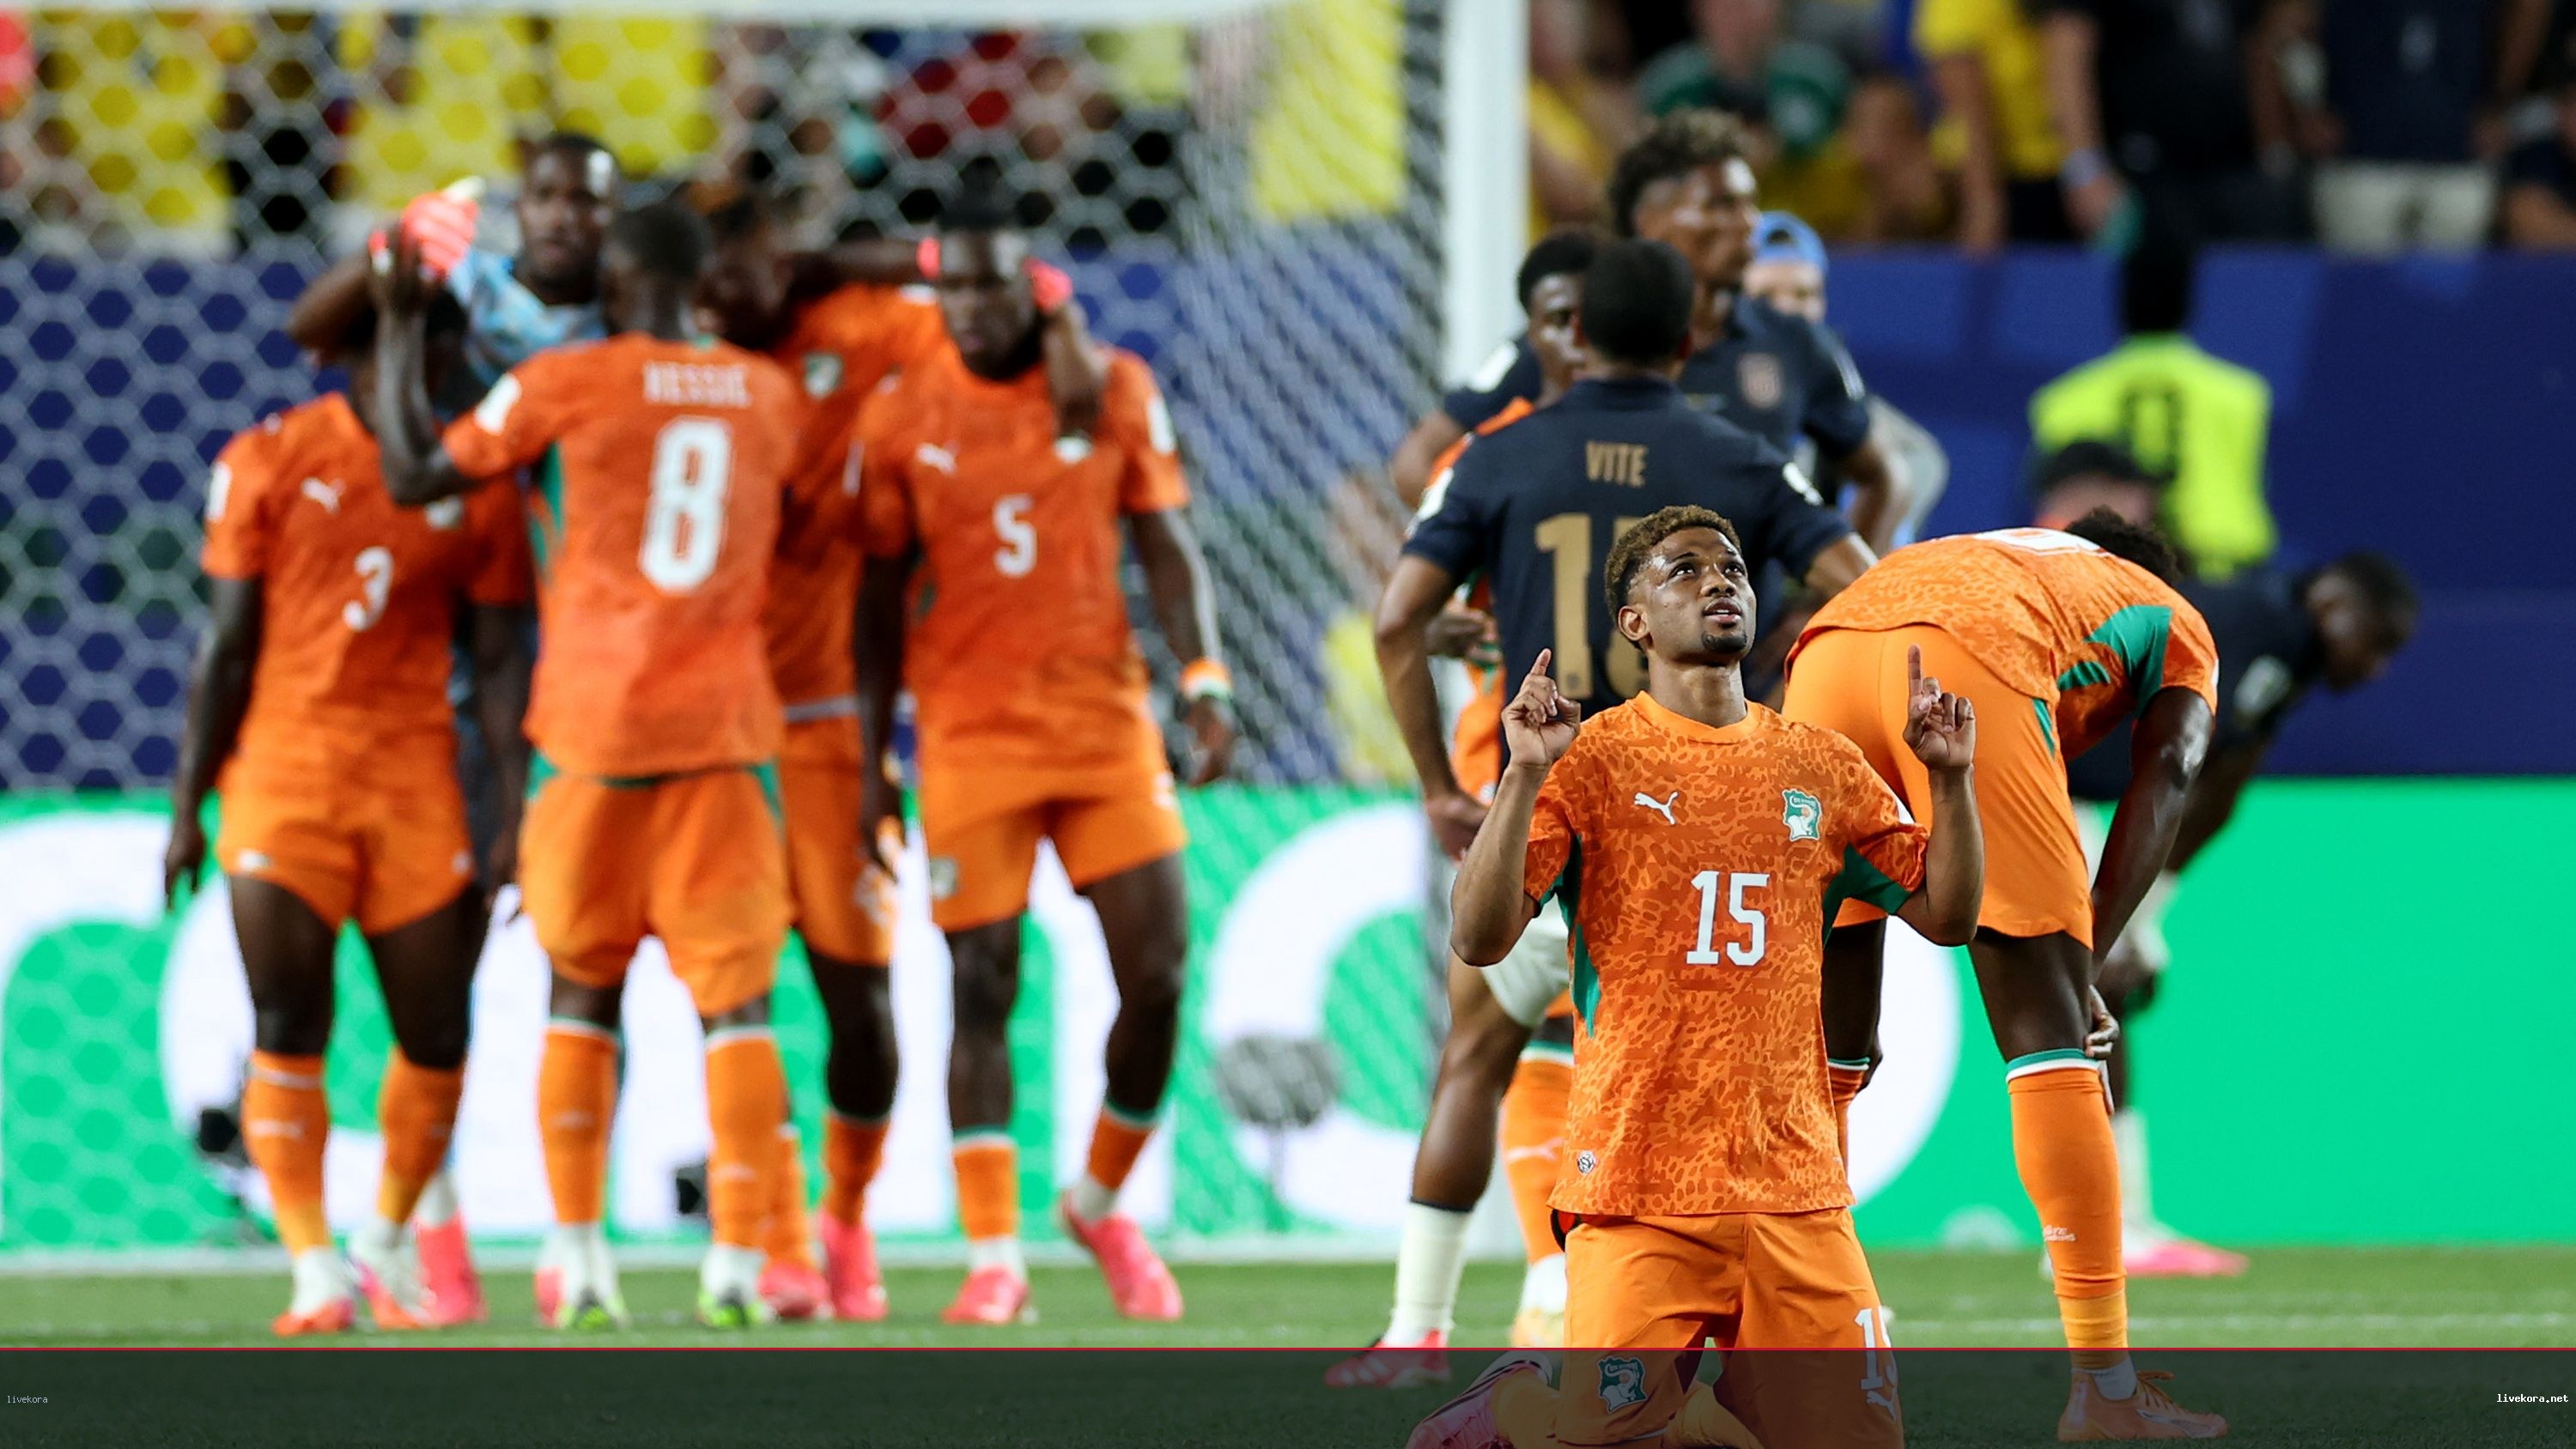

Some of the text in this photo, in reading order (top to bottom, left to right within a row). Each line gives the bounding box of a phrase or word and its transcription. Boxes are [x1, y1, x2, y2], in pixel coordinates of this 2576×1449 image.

[640, 415, 734, 591] 8
[1586, 440, 1648, 487] VITE
[993, 493, 1038, 578] 5
[345, 546, 394, 632] 3
[1686, 870, 1771, 967] 15
